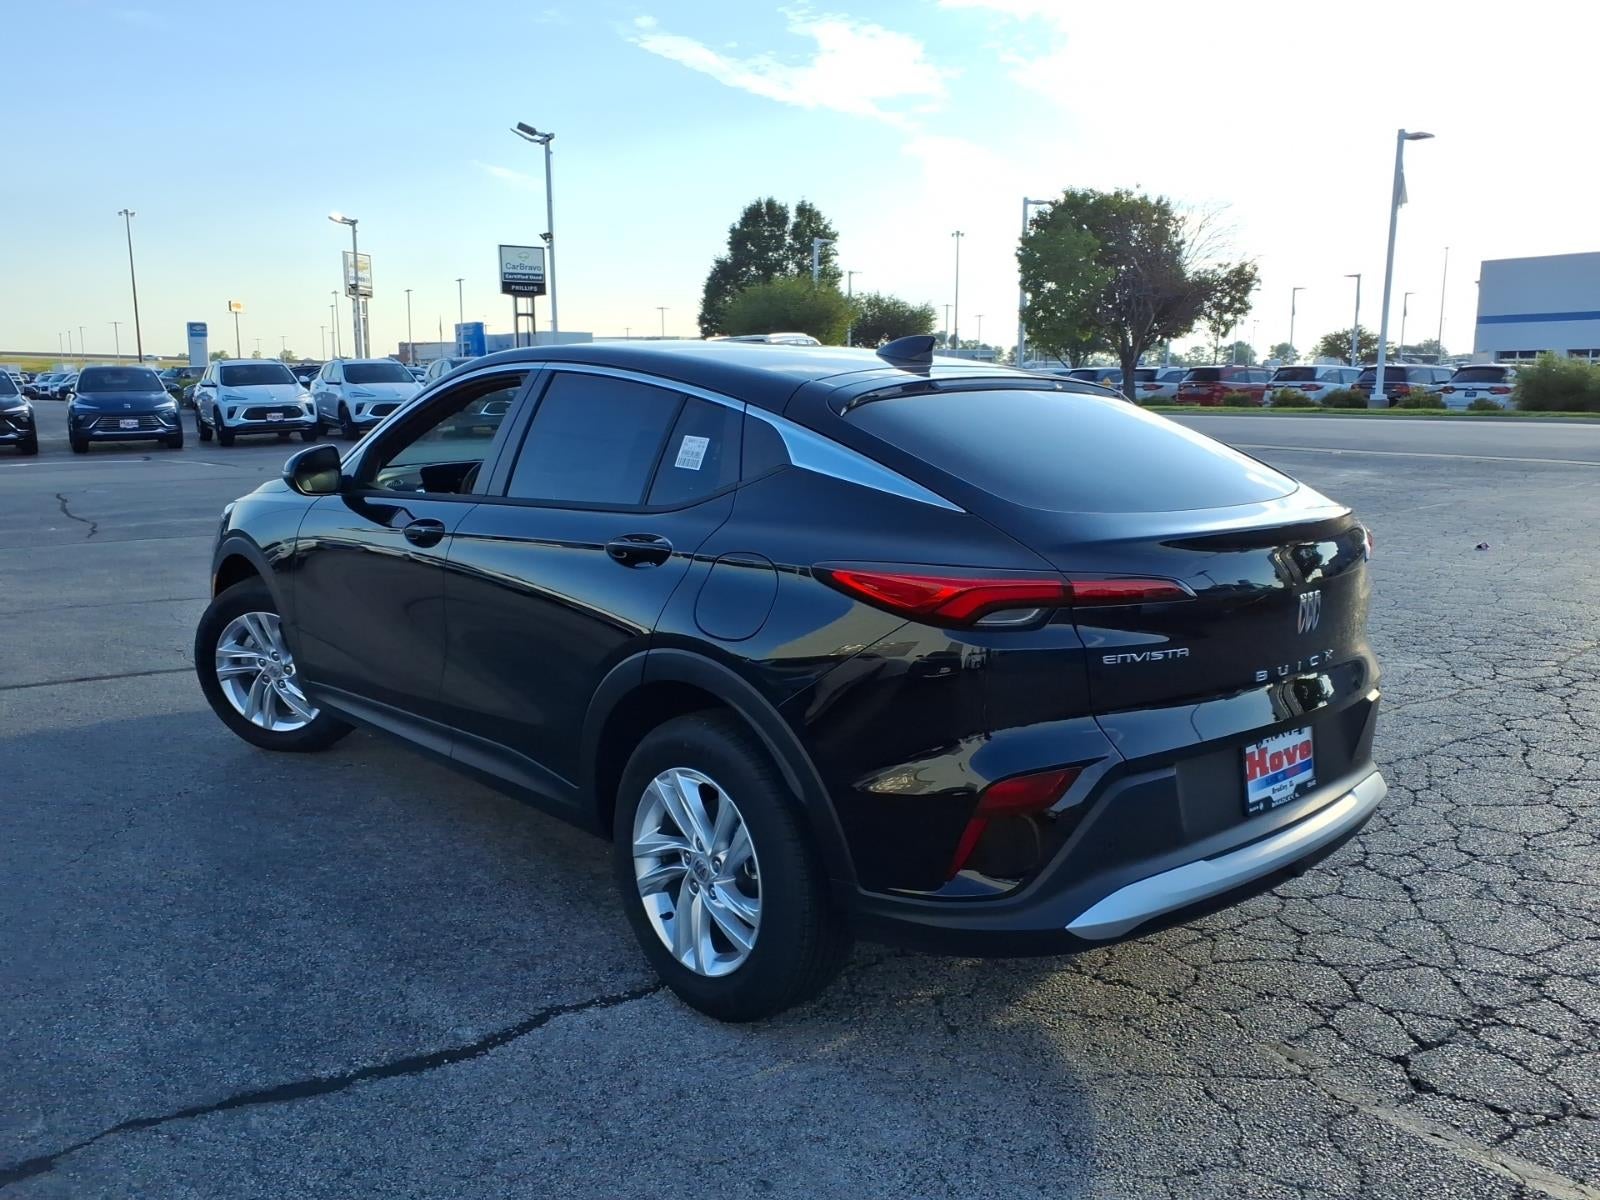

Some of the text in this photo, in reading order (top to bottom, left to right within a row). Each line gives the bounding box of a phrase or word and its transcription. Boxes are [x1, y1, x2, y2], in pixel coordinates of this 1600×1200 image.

[505, 262, 542, 272] CarBravo
[1102, 647, 1190, 665] ENVISTA
[1255, 649, 1334, 682] BUICK
